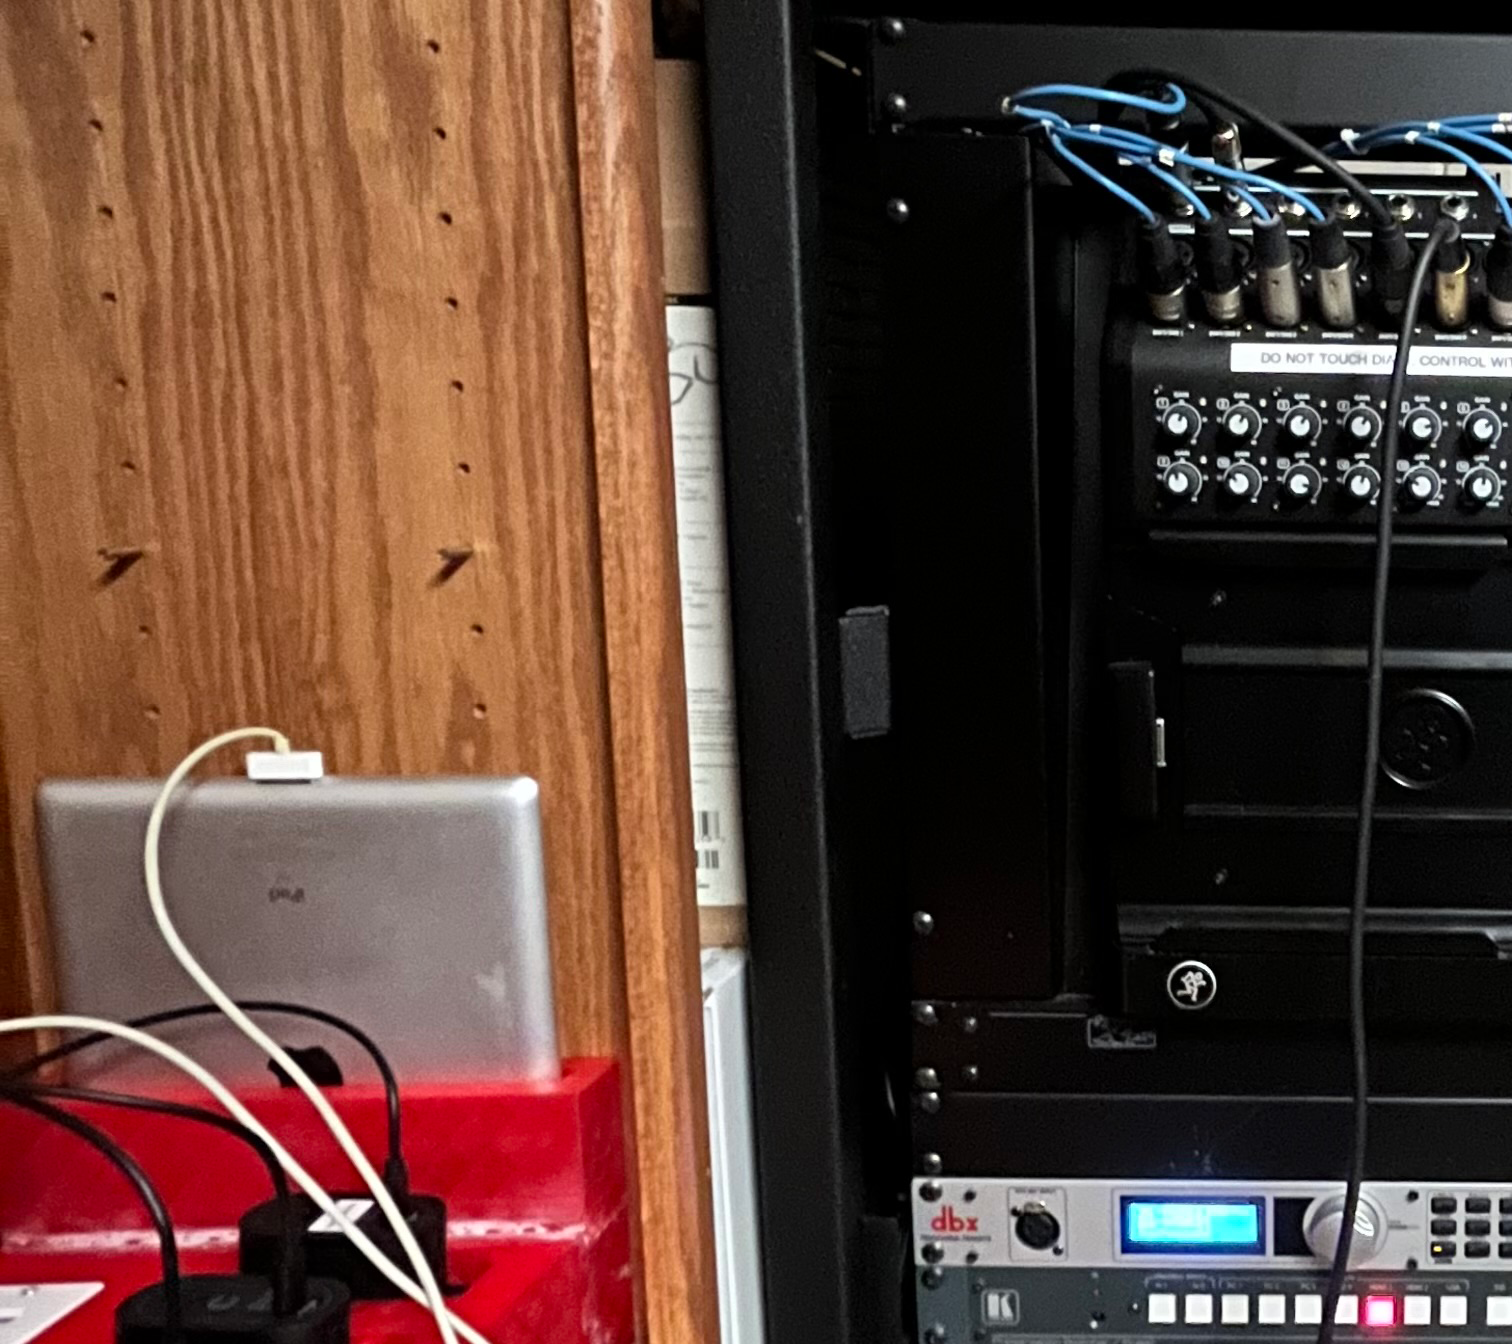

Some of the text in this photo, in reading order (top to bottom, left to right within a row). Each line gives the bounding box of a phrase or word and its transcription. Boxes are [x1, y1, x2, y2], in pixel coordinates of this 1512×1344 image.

[1261, 352, 1281, 364] DO
[1286, 352, 1313, 365] NOT
[1320, 353, 1368, 366] TOUCH
[1419, 355, 1486, 368] CONTROL
[930, 1205, 978, 1232] dbx
